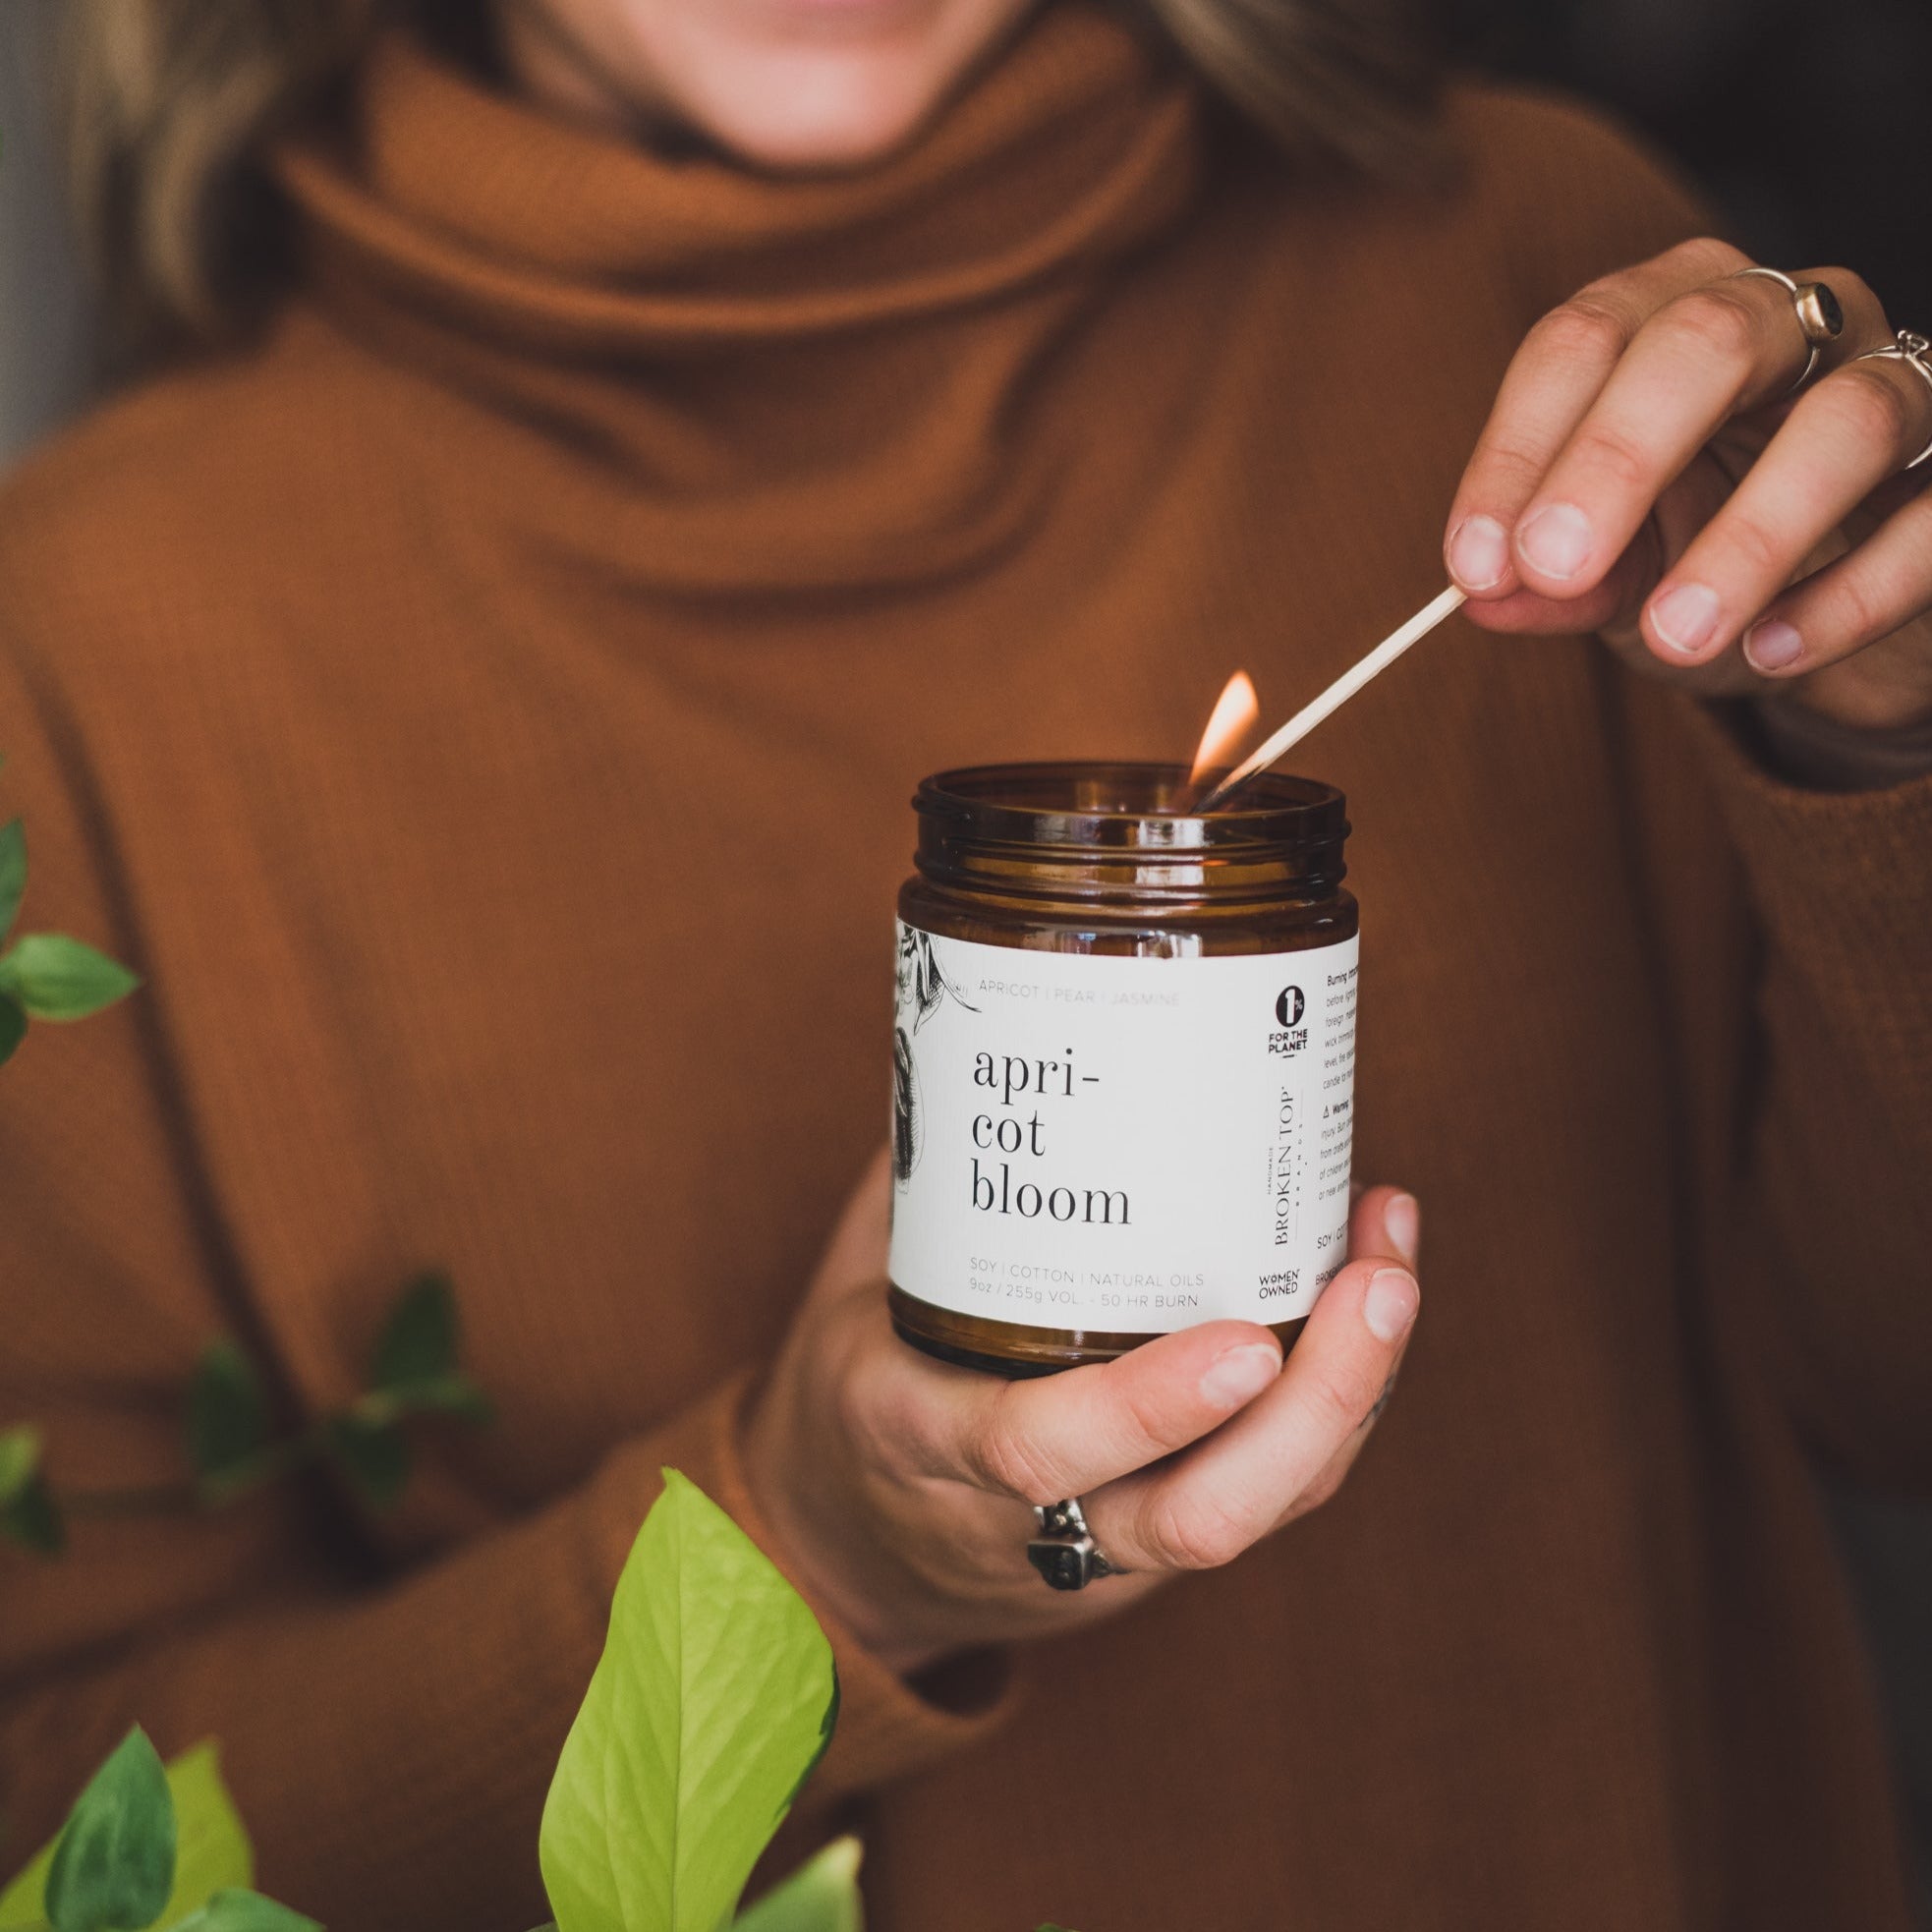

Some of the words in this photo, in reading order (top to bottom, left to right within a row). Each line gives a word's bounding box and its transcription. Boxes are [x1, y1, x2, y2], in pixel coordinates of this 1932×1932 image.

[979, 980, 1040, 998] APRICOT
[1054, 988, 1095, 1003] PEAR
[1110, 991, 1180, 1007] JASMINE
[1268, 1039, 1308, 1054] PLANET
[1269, 1032, 1289, 1043] FOR
[1291, 1029, 1308, 1040] THE
[974, 1048, 1100, 1107] apri-
[972, 1109, 1046, 1157] cot
[970, 1158, 1132, 1225] bloom
[1275, 1145, 1292, 1246] BROKEN
[1317, 1230, 1332, 1249] SOY
[970, 1257, 996, 1274] SOY
[1010, 1264, 1074, 1283] COTTON
[1090, 1273, 1164, 1287] NATURAL
[1169, 1274, 1205, 1287] OILS
[969, 1278, 992, 1293] 9oz
[1006, 1284, 1043, 1304] 255g
[1101, 1294, 1121, 1308] 50
[1127, 1294, 1149, 1308] HR
[1155, 1294, 1199, 1308] BURN
[1259, 1281, 1298, 1299] OWNED
